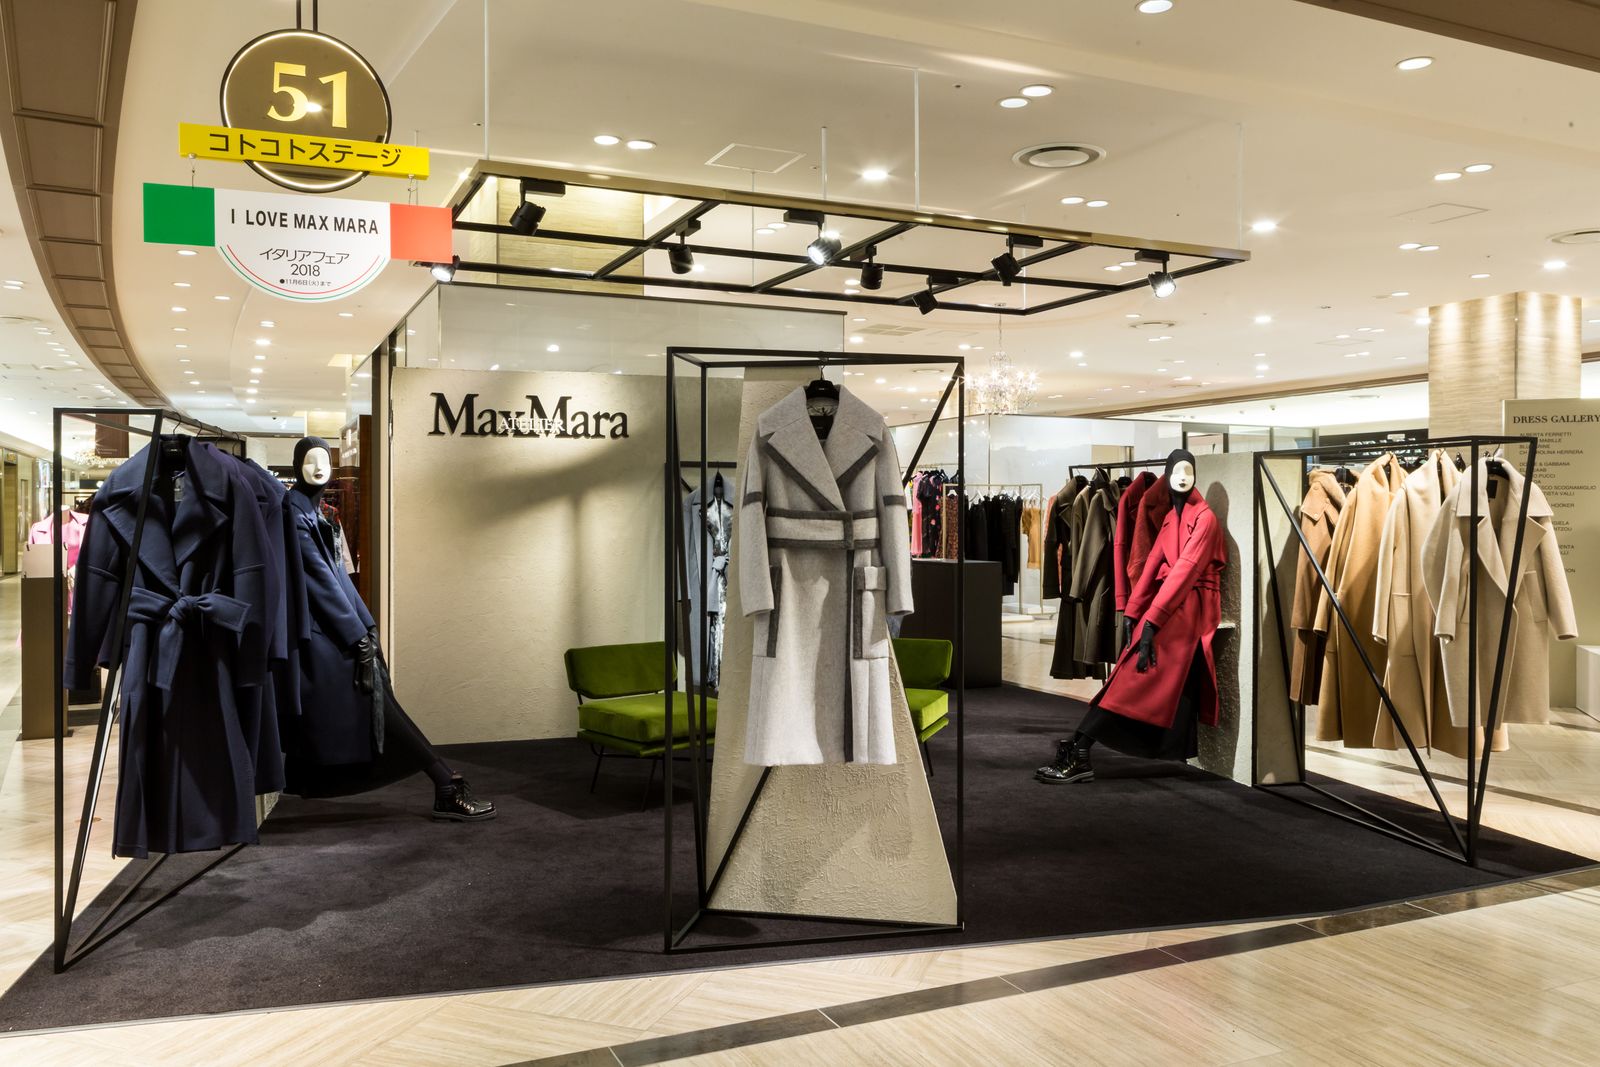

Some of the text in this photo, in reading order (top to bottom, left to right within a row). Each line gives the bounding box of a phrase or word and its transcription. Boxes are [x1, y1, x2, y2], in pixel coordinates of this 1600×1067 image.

[267, 62, 347, 129] 51
[209, 133, 401, 167] コトコトステージ
[231, 208, 379, 235] I LOVE MAX MARA
[259, 248, 350, 265] イタリアフェア
[290, 263, 321, 277] 2018
[427, 392, 629, 439] MaxMara
[499, 417, 565, 432] ATELIER
[1513, 415, 1600, 424] DRESS GALLERY
